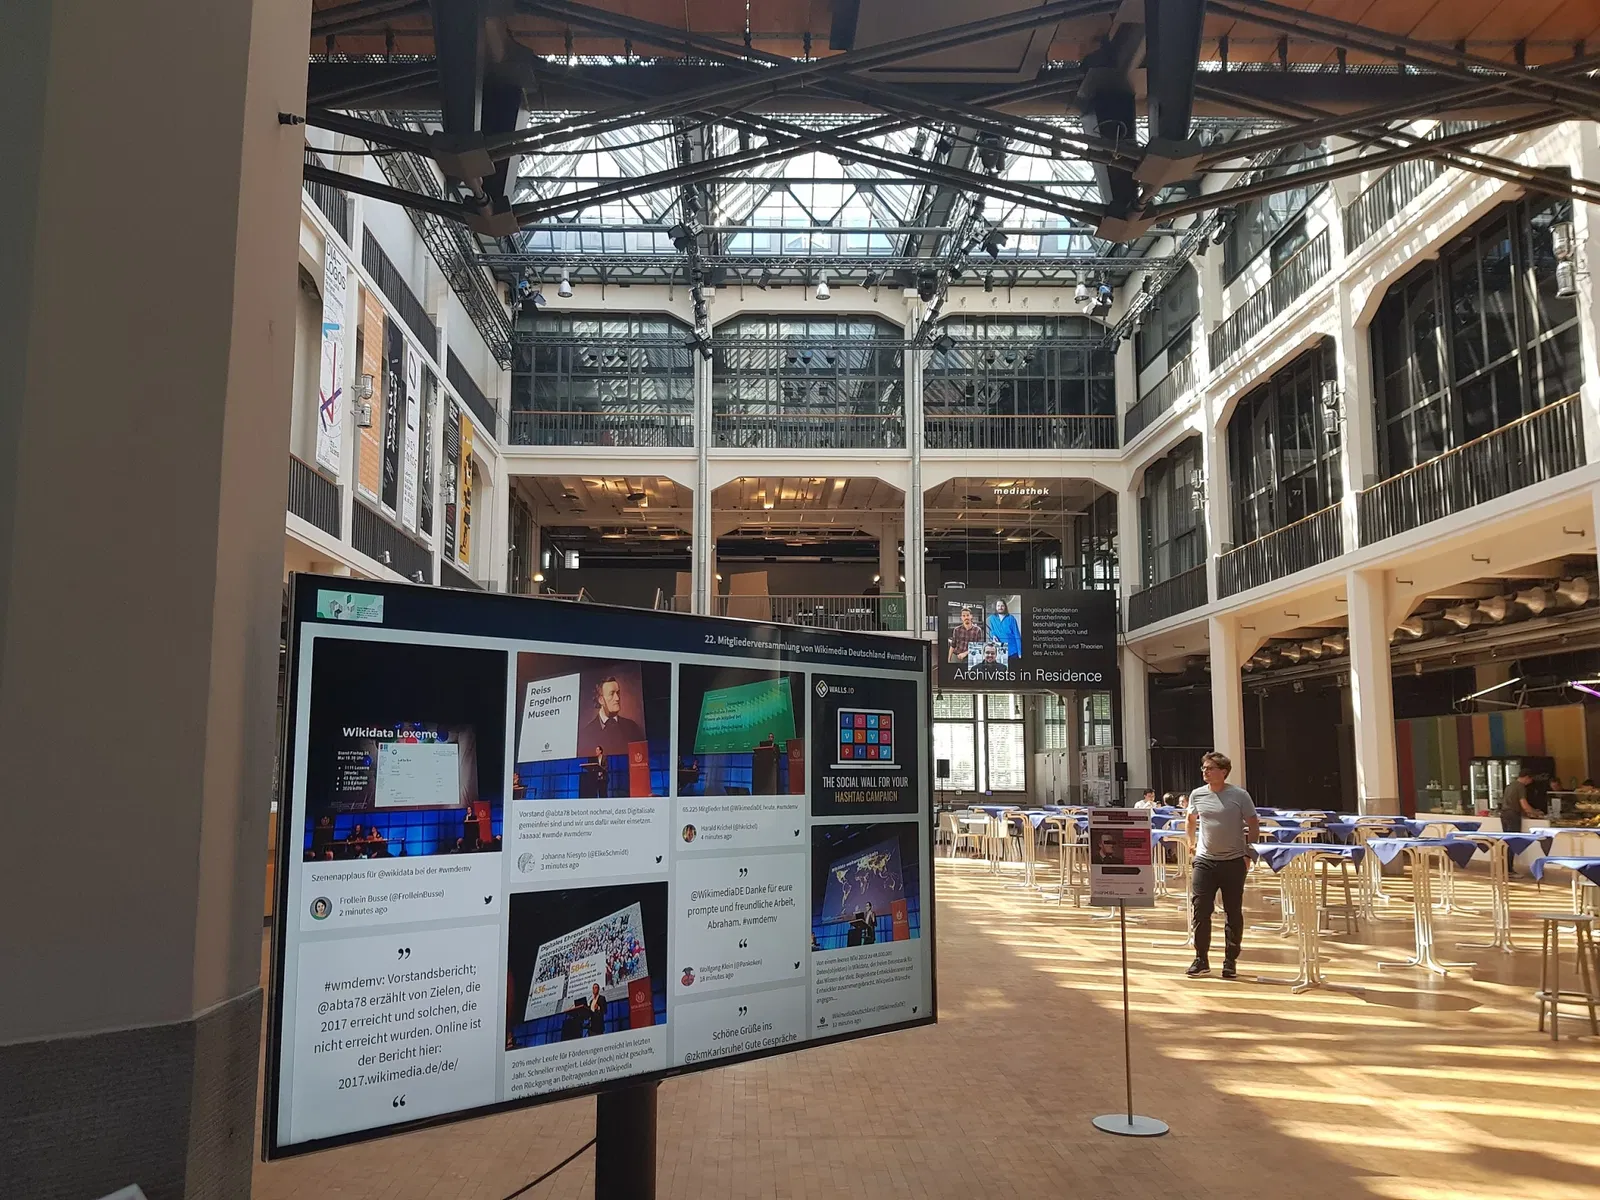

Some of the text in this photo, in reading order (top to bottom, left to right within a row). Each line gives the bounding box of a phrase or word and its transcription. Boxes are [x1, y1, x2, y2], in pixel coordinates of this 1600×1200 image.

[326, 256, 345, 289] LOGOS
[704, 635, 916, 662] 22. Mitgliederversammlung von Wikimedia Deutschland #wmdemv
[954, 668, 1102, 682] Archivists in Residence
[530, 685, 551, 696] Reiss
[530, 694, 571, 707] Engelhorn
[528, 708, 560, 719] Museen
[343, 727, 394, 738] Wikidata
[823, 777, 908, 788] THE SOCIAL WALL FOR YOUR
[835, 791, 898, 802] HASHTAG CAMPAIGN
[519, 820, 549, 830] gemeinfrei
[312, 871, 365, 882] Szenenapplaus
[367, 870, 376, 878] für
[378, 869, 414, 880] @wikidata
[340, 889, 444, 905] Frollein Busse (@FrolleinBusse)
[691, 887, 744, 901] @WikimediaDE
[746, 885, 766, 895] Danke
[768, 884, 776, 892] für
[345, 907, 373, 916] minutes
[375, 907, 388, 915] ago
[688, 897, 796, 918] prompte und freundliche Arbeit,
[707, 915, 778, 929] Abraham. #wmdemv
[324, 964, 477, 992] #wmdemv: Vorstandsbericht;
[317, 981, 481, 1015] @abta78 erzählt von Zielen, die
[321, 1001, 477, 1032] 2017 erreicht und solchen, die
[314, 1019, 481, 1054] nicht erreicht wurden. Online ist
[712, 1022, 772, 1040] Schöne Grüße ins
[358, 1044, 442, 1067] der Bericht hier:
[604, 1042, 624, 1052] erreicht
[685, 1032, 797, 1064] @zkmKarlsruhe! Gute Gespräche
[580, 1058, 597, 1068] Leider
[616, 1051, 629, 1060] nicht
[338, 1058, 459, 1090] 2017.wikimedia.de/de/
[511, 1083, 523, 1092] den
[524, 1077, 552, 1091] Rückgang
[606, 1062, 632, 1073] Wikipedia
